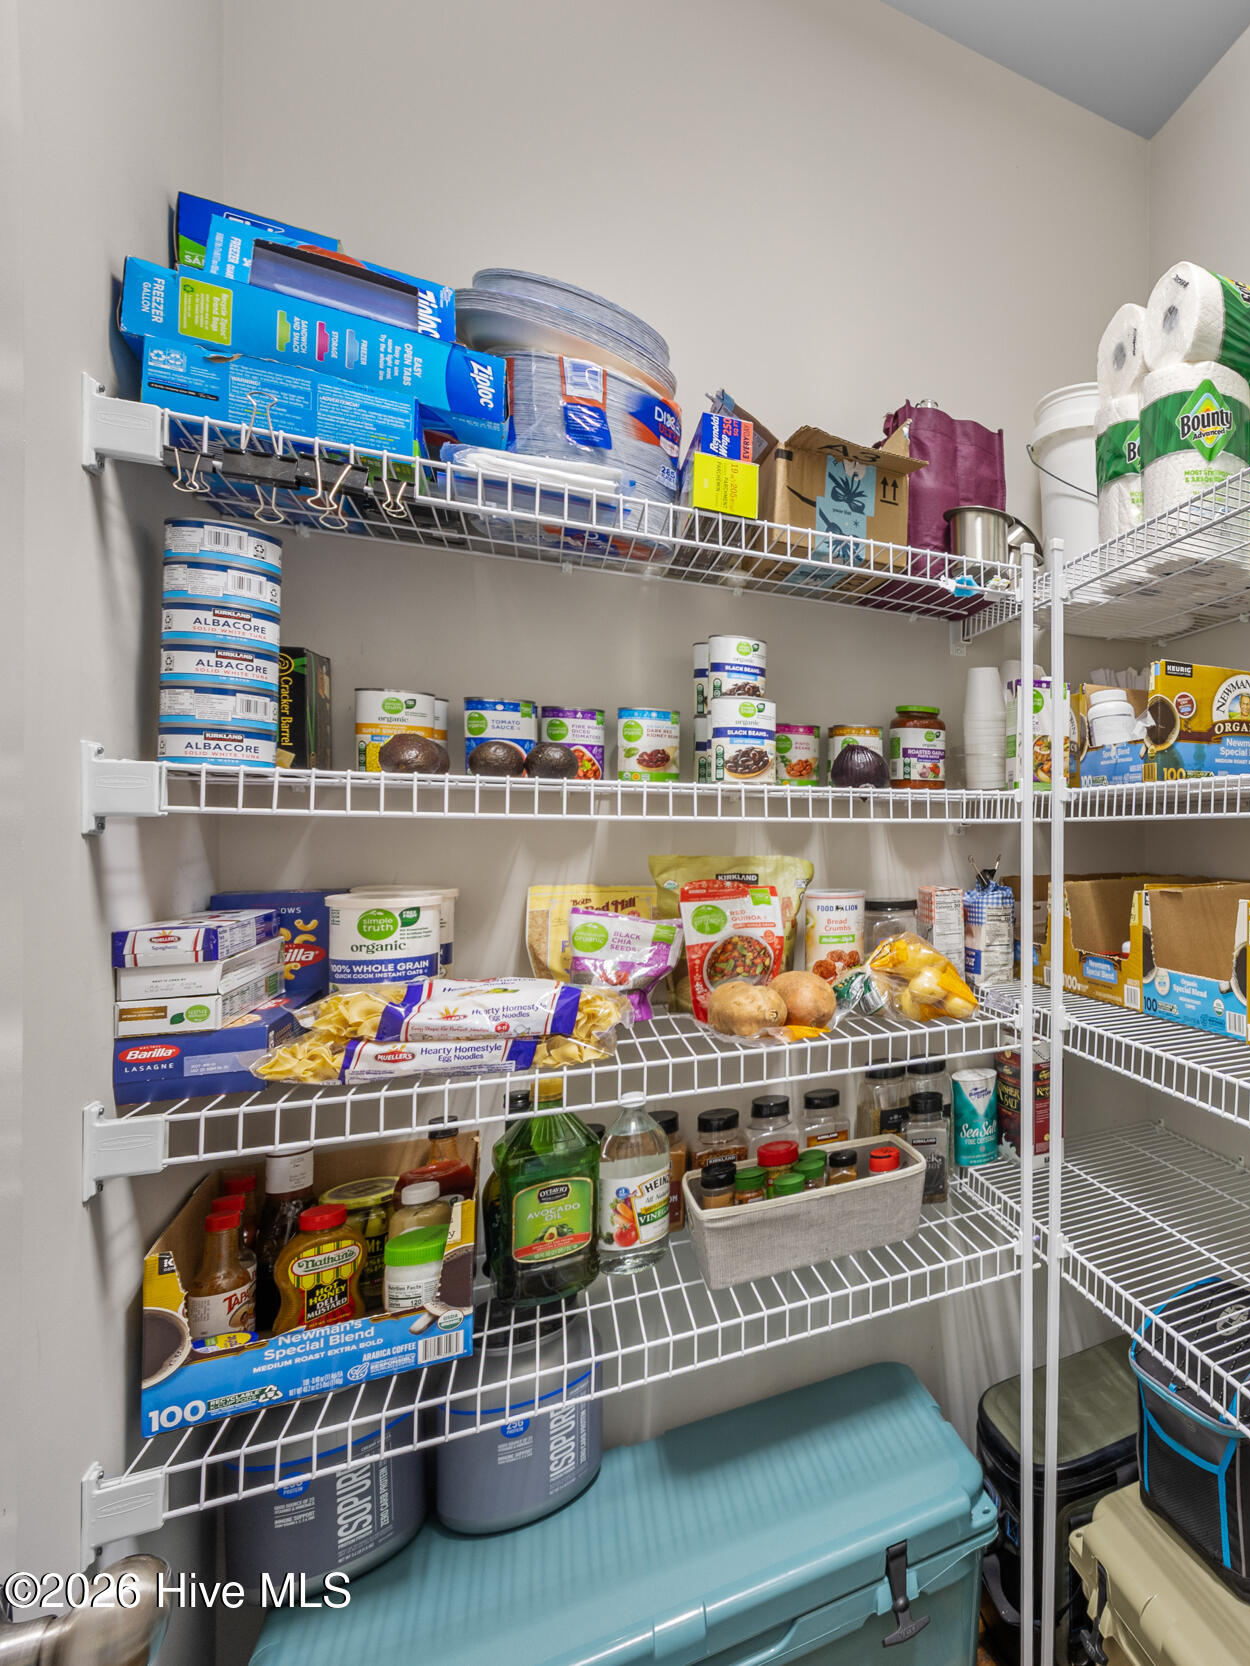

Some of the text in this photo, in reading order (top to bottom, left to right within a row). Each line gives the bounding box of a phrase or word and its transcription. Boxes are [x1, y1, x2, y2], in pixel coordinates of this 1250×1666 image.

[141, 281, 150, 312] GALLON
[153, 277, 166, 323] FREEZER
[418, 290, 441, 338] Ziploc
[403, 343, 413, 386] OPEN TABS
[414, 357, 423, 378] EASY
[470, 359, 494, 408] Ziploc
[723, 417, 732, 436] 250
[1180, 409, 1232, 440] Bounty
[709, 415, 719, 454] Reynolds
[1193, 428, 1225, 441] Advanced
[719, 435, 731, 458] Wrap
[215, 609, 252, 619] KIRKLAND
[193, 618, 266, 634] ALBACORE
[217, 651, 253, 660] KIRKLAND
[196, 659, 268, 674] ALBACORE
[1167, 664, 1192, 674] KEURIG
[280, 677, 293, 746] Cracker Barrel
[491, 719, 521, 727] TOMATO
[206, 733, 243, 741] KIRKLAND
[184, 742, 259, 754] ALBACORE
[1219, 747, 1247, 758] Special
[719, 874, 757, 882] KIRKLAND
[816, 904, 858, 912] FOOD LION
[362, 917, 393, 928] simple
[362, 922, 393, 932] truth
[824, 924, 852, 932] Crumbs
[151, 935, 180, 943] MUELLER'S
[612, 938, 631, 946] CHIA
[613, 932, 641, 941] BLACK
[351, 940, 406, 954] organic
[610, 944, 636, 952] SEEDS
[352, 962, 391, 972] WHOLE
[394, 960, 429, 970] GRAIN
[1173, 984, 1207, 998] Special Blend
[1144, 997, 1158, 1012] 100
[127, 1047, 173, 1060] Barilla
[378, 1052, 414, 1062] MUELLER'S
[420, 1044, 502, 1057] Hearty Homestyle
[438, 1053, 484, 1063] Egg Noodles
[125, 1063, 174, 1072] LASAGNE
[960, 1120, 997, 1139] Sea Salt
[708, 1155, 736, 1164] KIRKLAND
[539, 1186, 568, 1198] OTTAVIO
[526, 1202, 580, 1222] AVOCADO
[545, 1212, 563, 1222] OIL
[298, 1248, 356, 1270] Nathan's
[316, 1283, 338, 1296] HOT
[309, 1286, 346, 1307] HONEY
[316, 1294, 338, 1308] DELI
[411, 1299, 422, 1307] 120
[307, 1297, 347, 1321] MUSTARD
[278, 1320, 362, 1346] Newman's
[264, 1327, 375, 1361] Special Blend
[253, 1338, 383, 1374] MEDIUM ROAST EXTRA BOLD
[362, 1342, 416, 1362] ARABICA COFFEE
[209, 1390, 260, 1405] RECYCLABLE
[148, 1400, 206, 1433] 100
